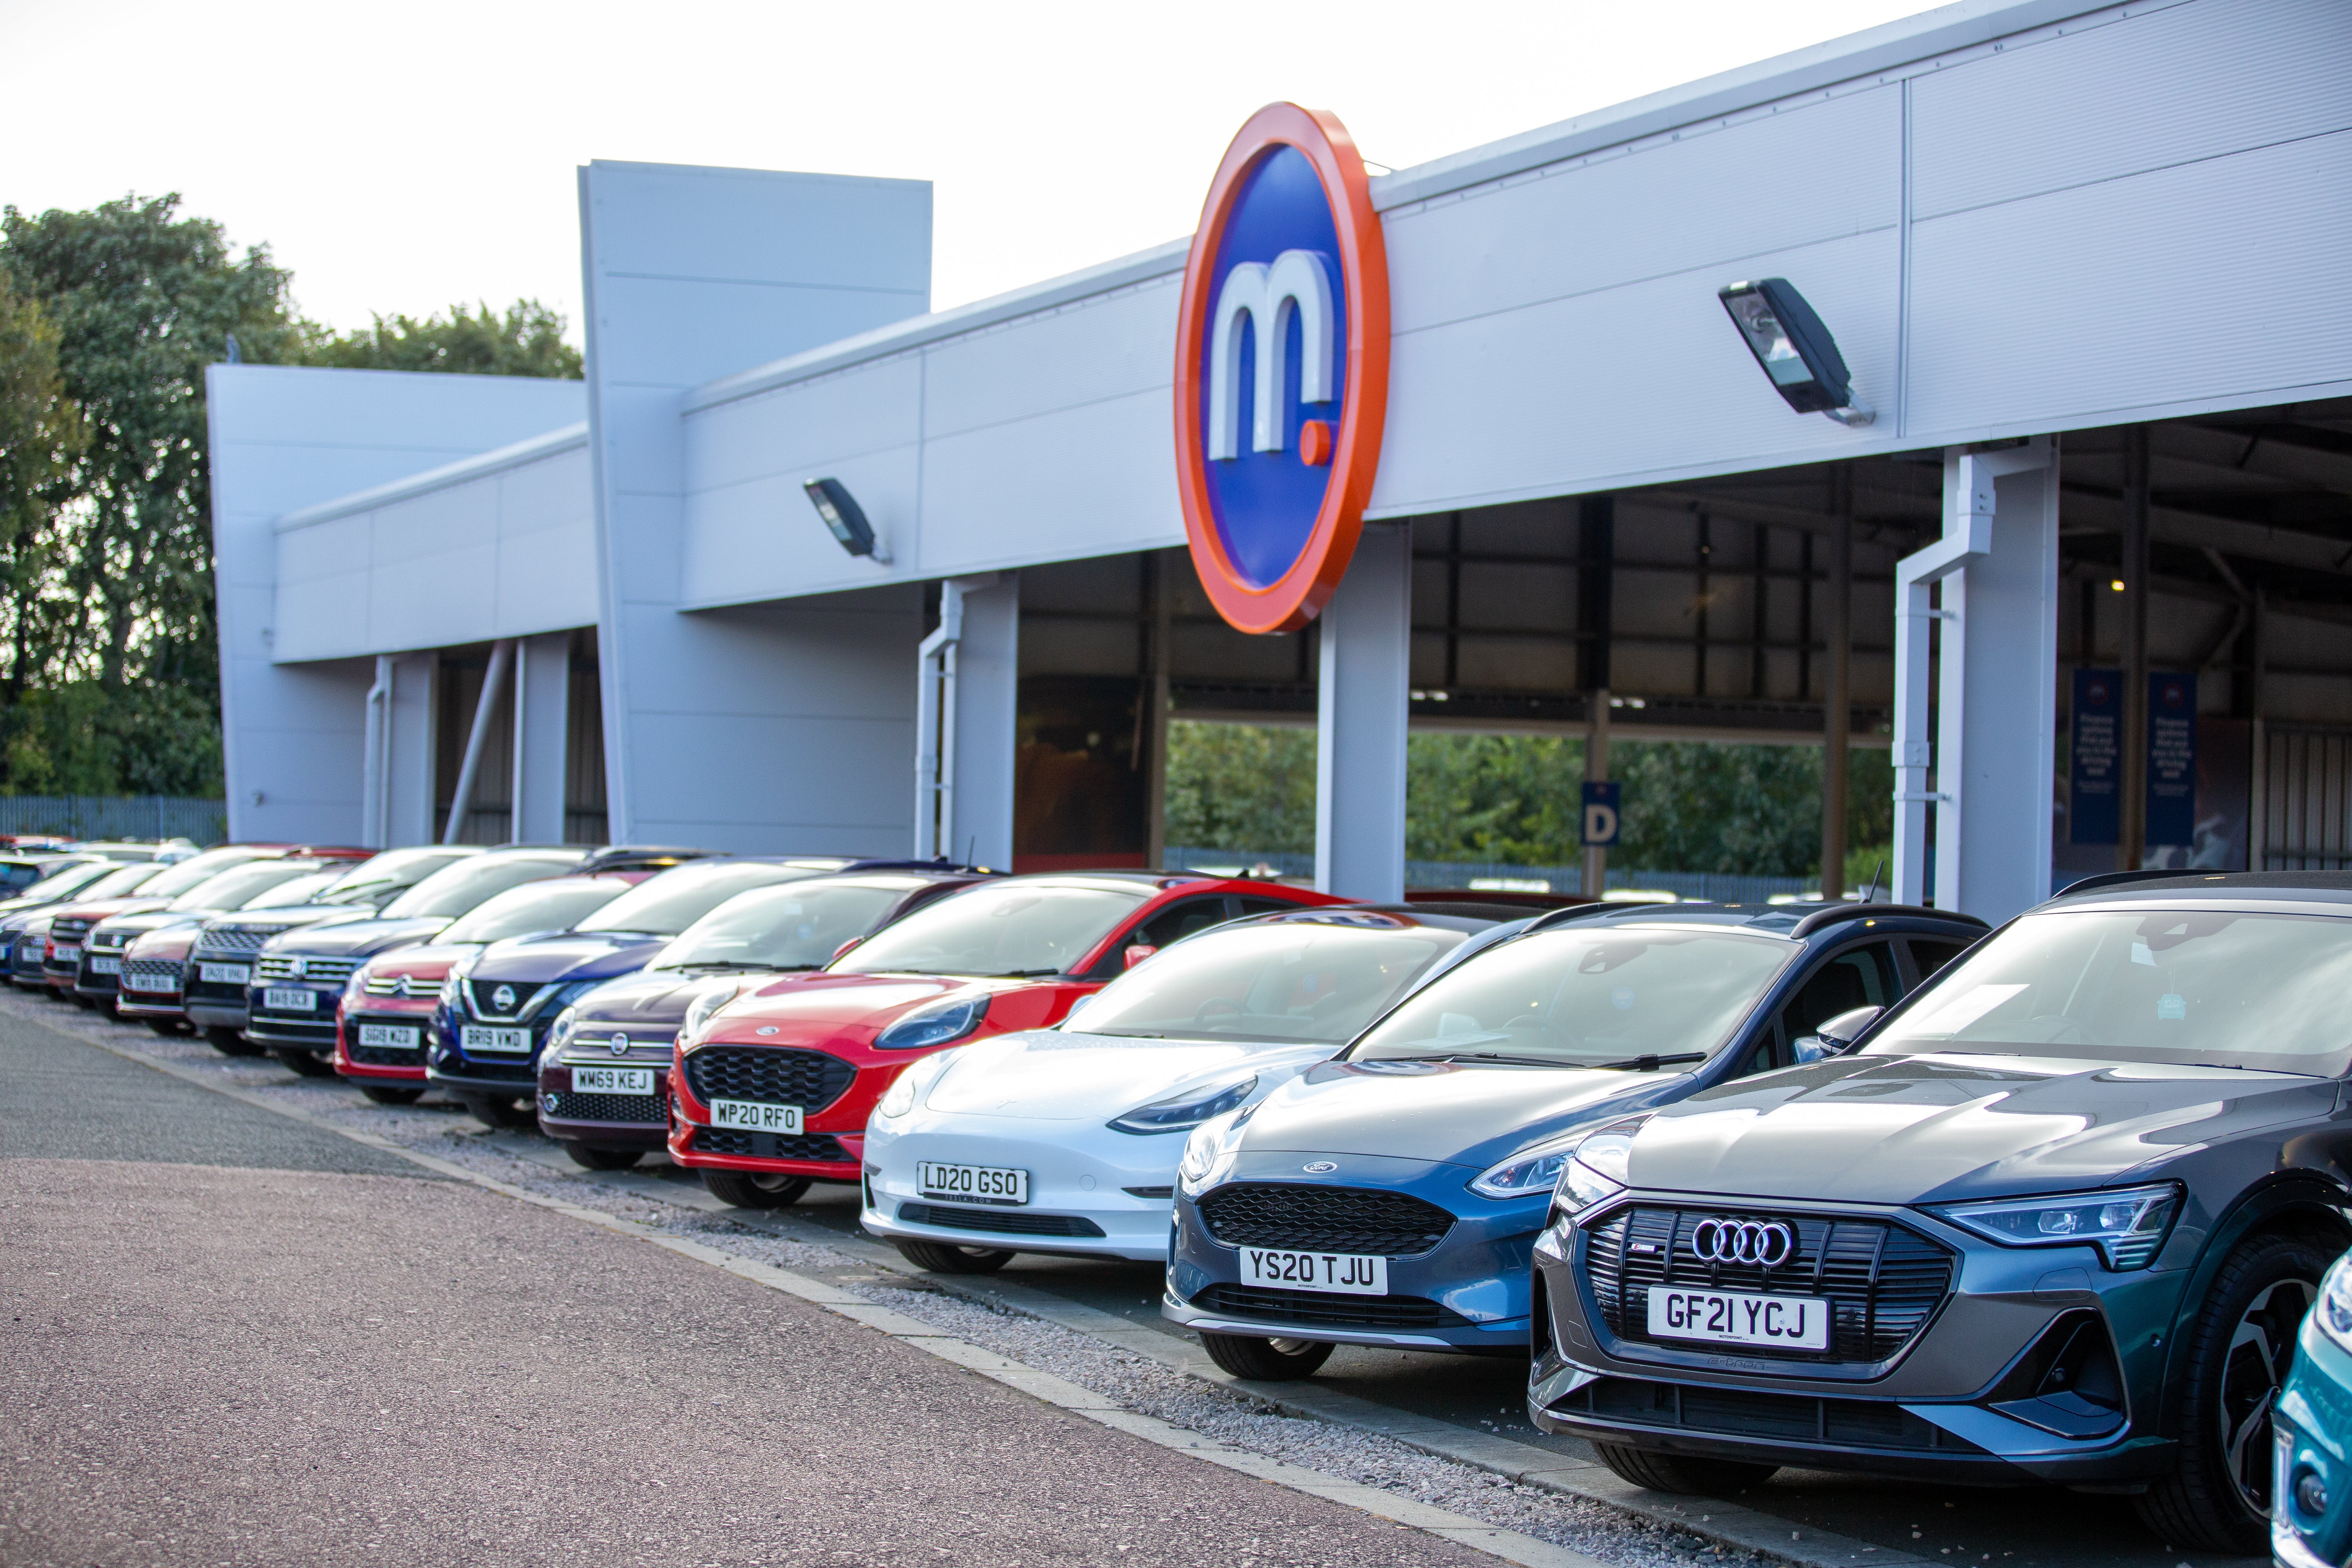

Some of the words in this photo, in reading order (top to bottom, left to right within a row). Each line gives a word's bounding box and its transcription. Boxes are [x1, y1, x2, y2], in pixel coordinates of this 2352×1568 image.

[1585, 804, 1617, 842] D
[468, 1029, 492, 1045] BR19
[579, 1070, 613, 1088] WM69
[618, 1071, 647, 1089] KEJ
[718, 1103, 758, 1125] WP20
[764, 1107, 795, 1128] RFO
[925, 1165, 971, 1192] LD20
[979, 1171, 1017, 1195] GSO
[945, 1195, 991, 1204] TESLA.COM
[1250, 1250, 1314, 1282] YS20
[1322, 1256, 1374, 1286] TJU
[1667, 1294, 1733, 1333] GF21
[1744, 1300, 1805, 1338] YCJ
[1708, 1356, 1766, 1370] e-tron
